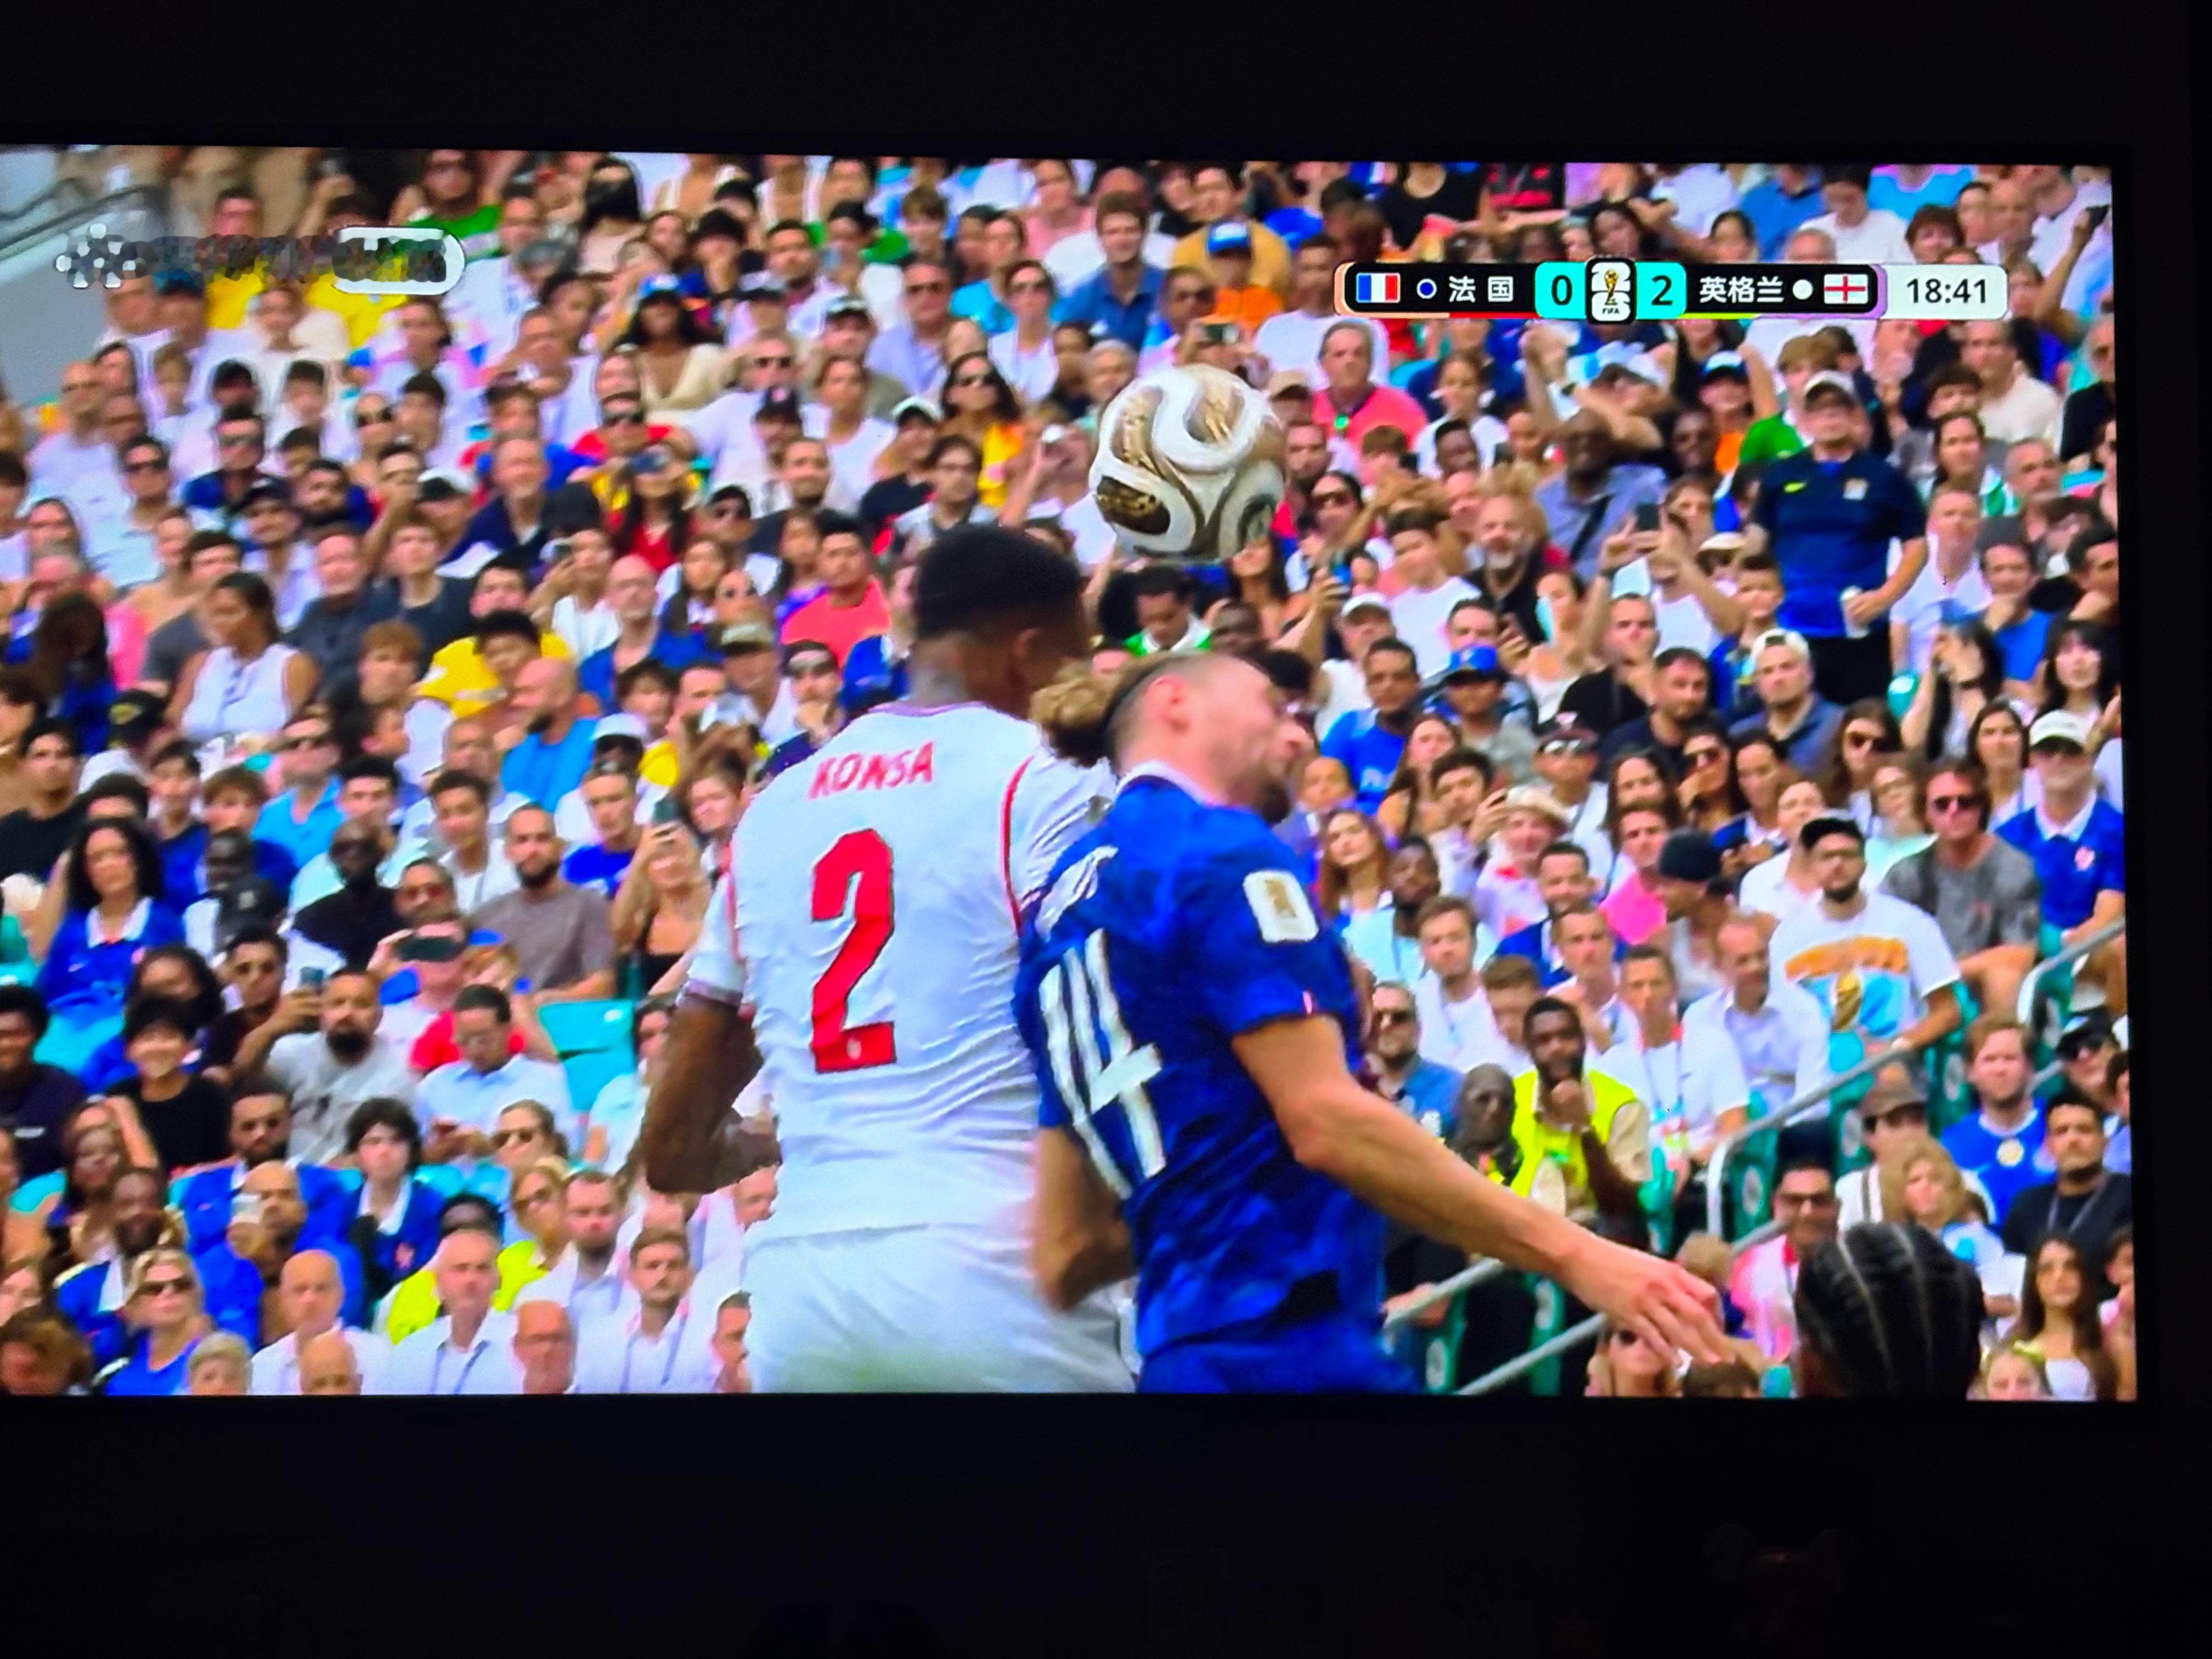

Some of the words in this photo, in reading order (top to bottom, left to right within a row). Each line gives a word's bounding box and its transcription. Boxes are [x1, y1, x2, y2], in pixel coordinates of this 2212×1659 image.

[1449, 275, 1514, 302] 法国
[1551, 275, 1573, 306] 0
[1651, 275, 1673, 306] 2
[1700, 276, 1784, 303] 英格兰
[1906, 279, 1985, 303] 18:41
[806, 741, 933, 800] KONSA
[811, 827, 897, 1074] 2
[1039, 927, 1166, 1200] 14
